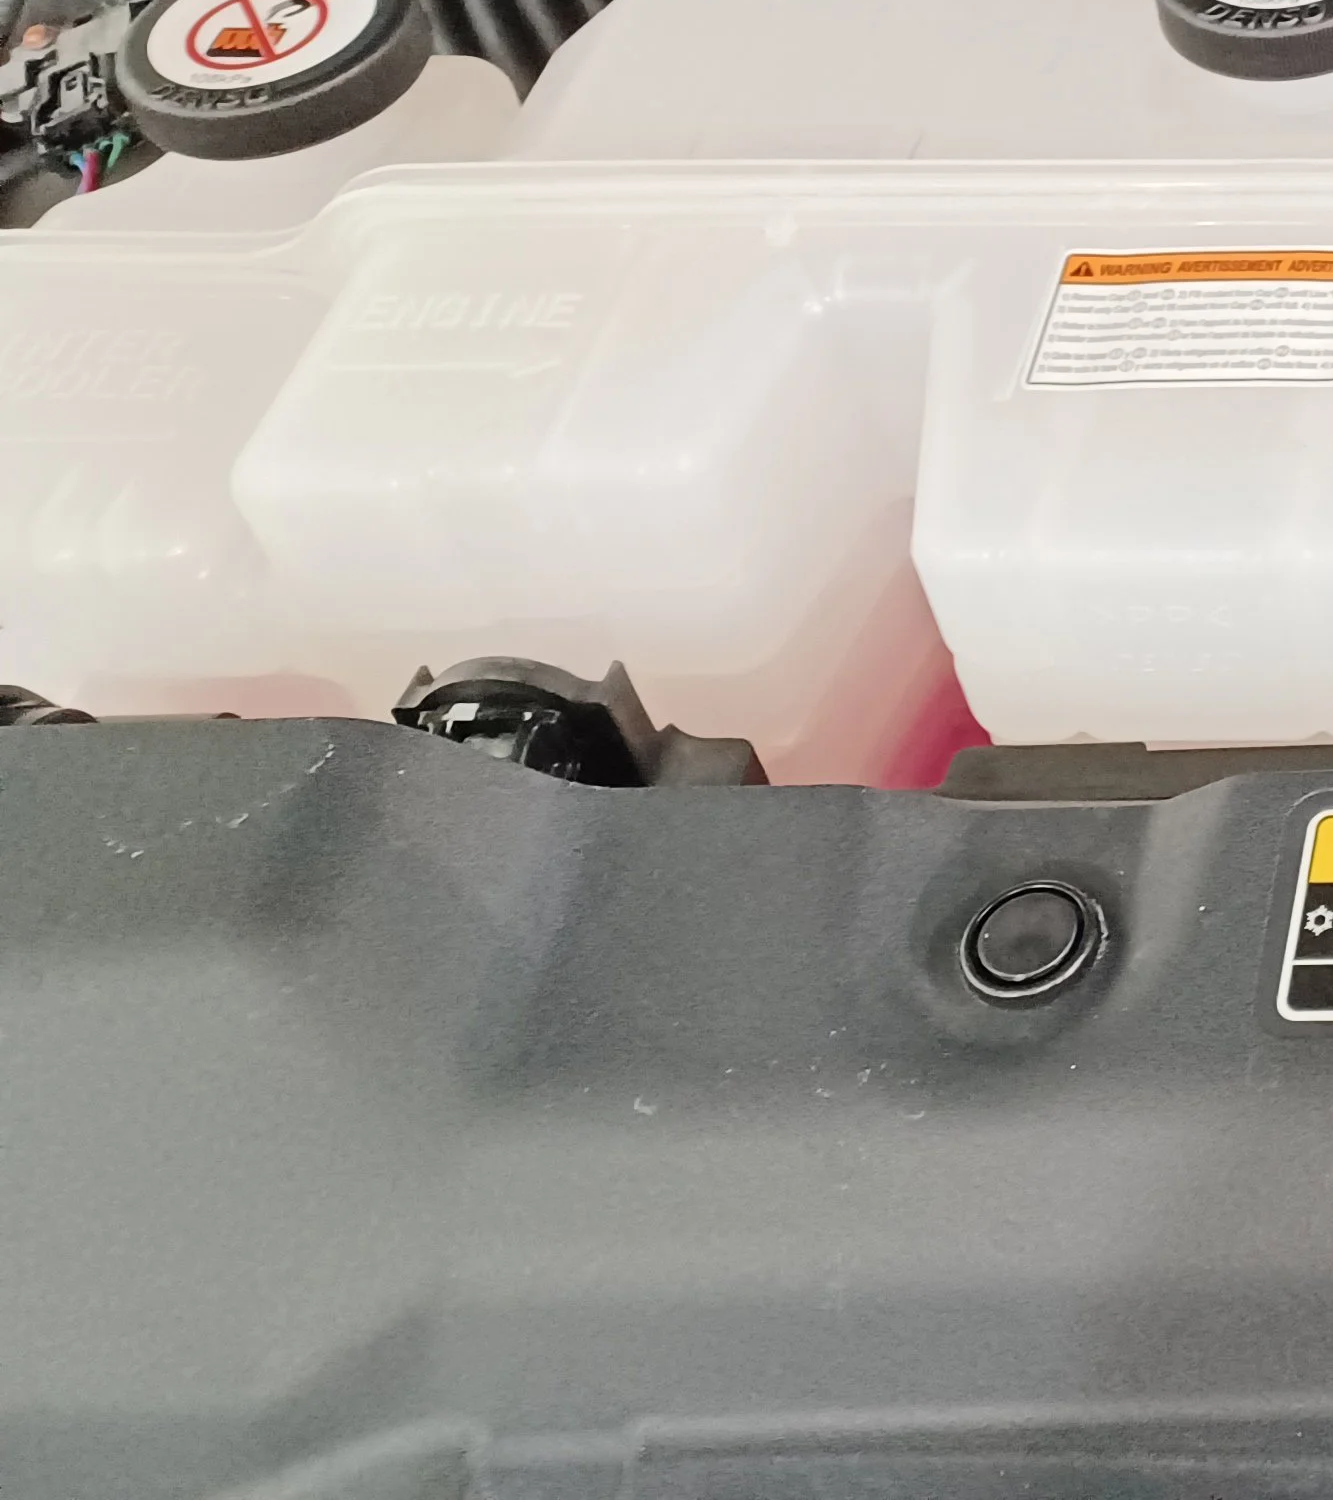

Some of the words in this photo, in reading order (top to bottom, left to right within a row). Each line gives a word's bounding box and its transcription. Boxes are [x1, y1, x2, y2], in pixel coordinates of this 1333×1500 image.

[1196, 2, 1327, 30] DENSO
[1099, 261, 1173, 277] WARNING
[1176, 259, 1283, 274] AVERTISSEMENT
[347, 289, 585, 331] ENGINE
